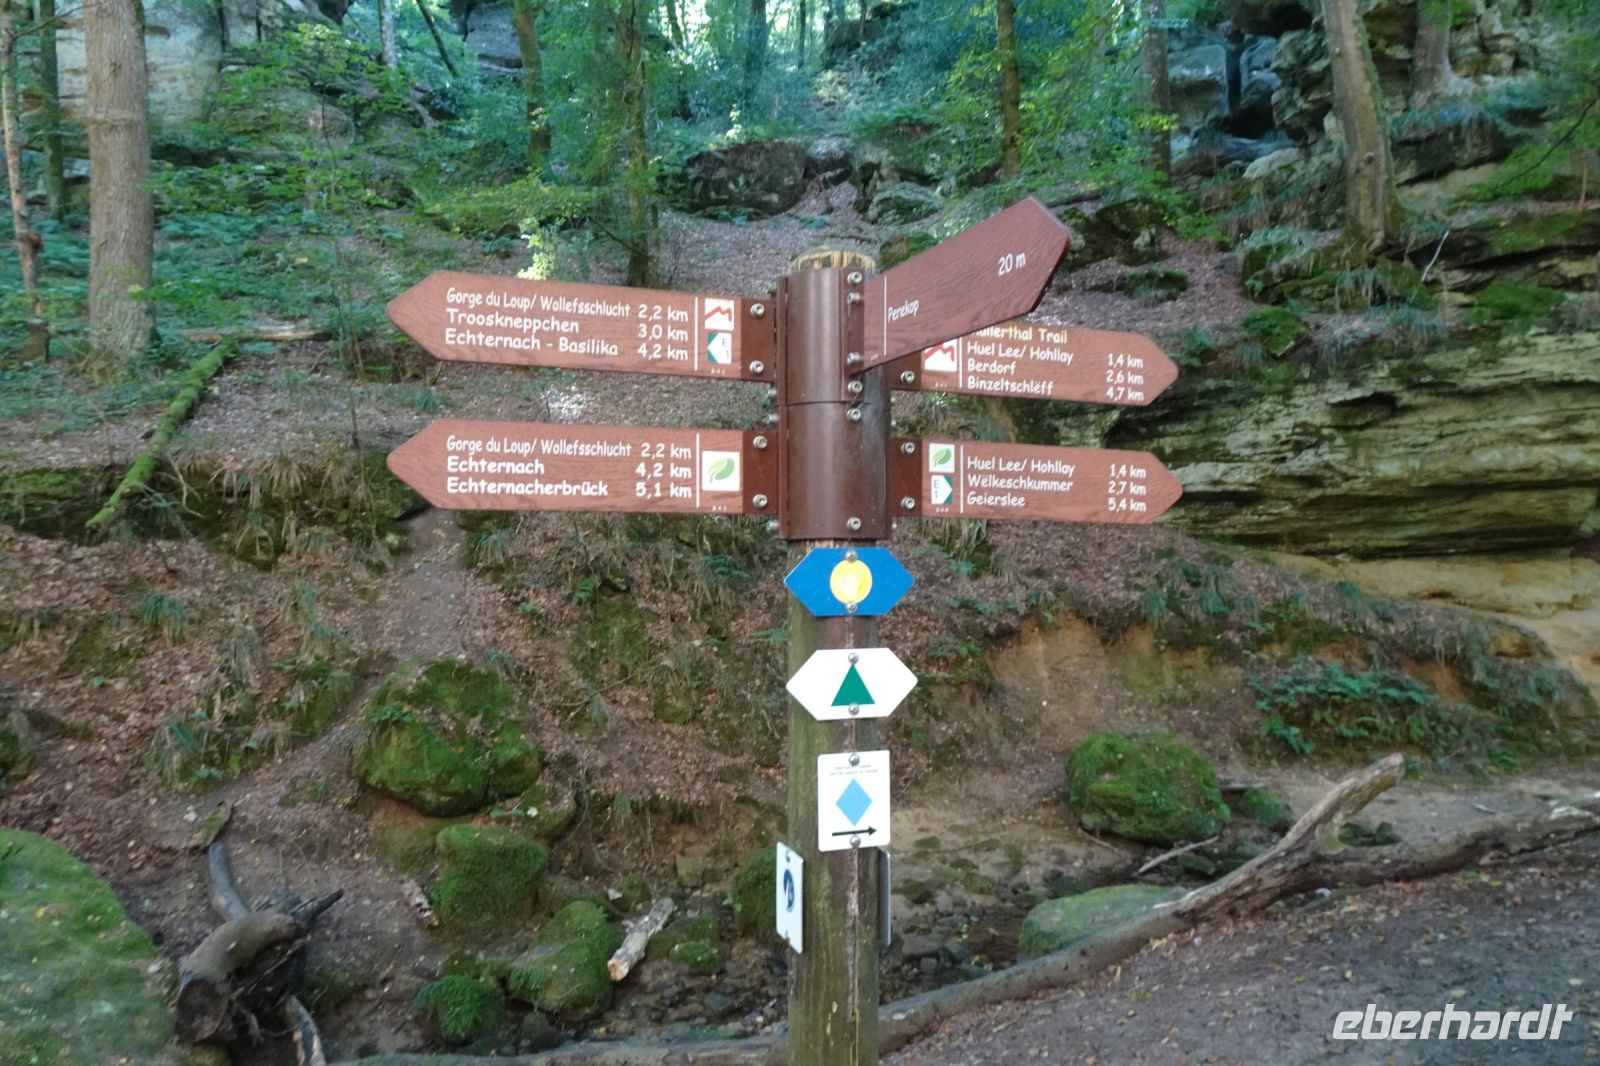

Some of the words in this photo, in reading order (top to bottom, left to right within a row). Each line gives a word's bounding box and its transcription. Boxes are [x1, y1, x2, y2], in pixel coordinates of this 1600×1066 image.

[998, 256, 1013, 275] 20
[1015, 252, 1026, 268] m
[446, 288, 483, 308] Gorge
[486, 289, 500, 306] du
[503, 291, 536, 313] Loup/
[540, 295, 630, 317] Wollefsschlucht
[638, 304, 663, 321] 2,2
[667, 307, 688, 322] km
[888, 299, 920, 322] Perekop
[446, 309, 579, 334] Trooskneppchen
[638, 323, 663, 340] 3,0
[667, 326, 688, 341] km
[972, 326, 1032, 340] llerthal
[1038, 328, 1067, 344] Trail
[445, 328, 540, 350] Echternach
[558, 339, 618, 356] Basilika
[637, 343, 663, 361] 4,2
[667, 346, 688, 361] km
[967, 341, 995, 355] Huel
[998, 343, 1027, 358] Lee/
[1030, 347, 1073, 366] Hohllay
[1108, 353, 1124, 368] 1,4
[1127, 354, 1144, 368] km
[967, 358, 1016, 375] Berdorf
[1106, 370, 1125, 384] 2,6
[1127, 371, 1144, 385] km
[967, 375, 1054, 396] Binzeltschlëff
[1106, 387, 1125, 402] 4,7
[1128, 387, 1144, 401] km
[446, 436, 483, 455] Gorge
[486, 437, 501, 453] du
[504, 438, 536, 458] Loup/
[540, 438, 631, 456] Wollefsschlucht
[641, 443, 665, 459] 2,2
[670, 444, 692, 458] km
[447, 456, 544, 475] Echternach
[635, 462, 665, 480] 4,2
[670, 463, 692, 478] km
[967, 456, 995, 470] Huel
[999, 458, 1027, 471] Lee/
[1031, 460, 1076, 478] Hohllay
[1110, 464, 1127, 478] 1,4
[1130, 464, 1147, 478] km
[447, 476, 608, 497] Echternacherbrück
[635, 482, 662, 500] 5,1
[670, 483, 692, 498] km
[967, 474, 1073, 492] Wëlkeschkummer
[1108, 481, 1127, 495] 2,7
[1130, 482, 1147, 495] km
[967, 492, 1026, 507] Geierslee
[1108, 498, 1127, 512] 5,4
[1130, 498, 1147, 512] km
